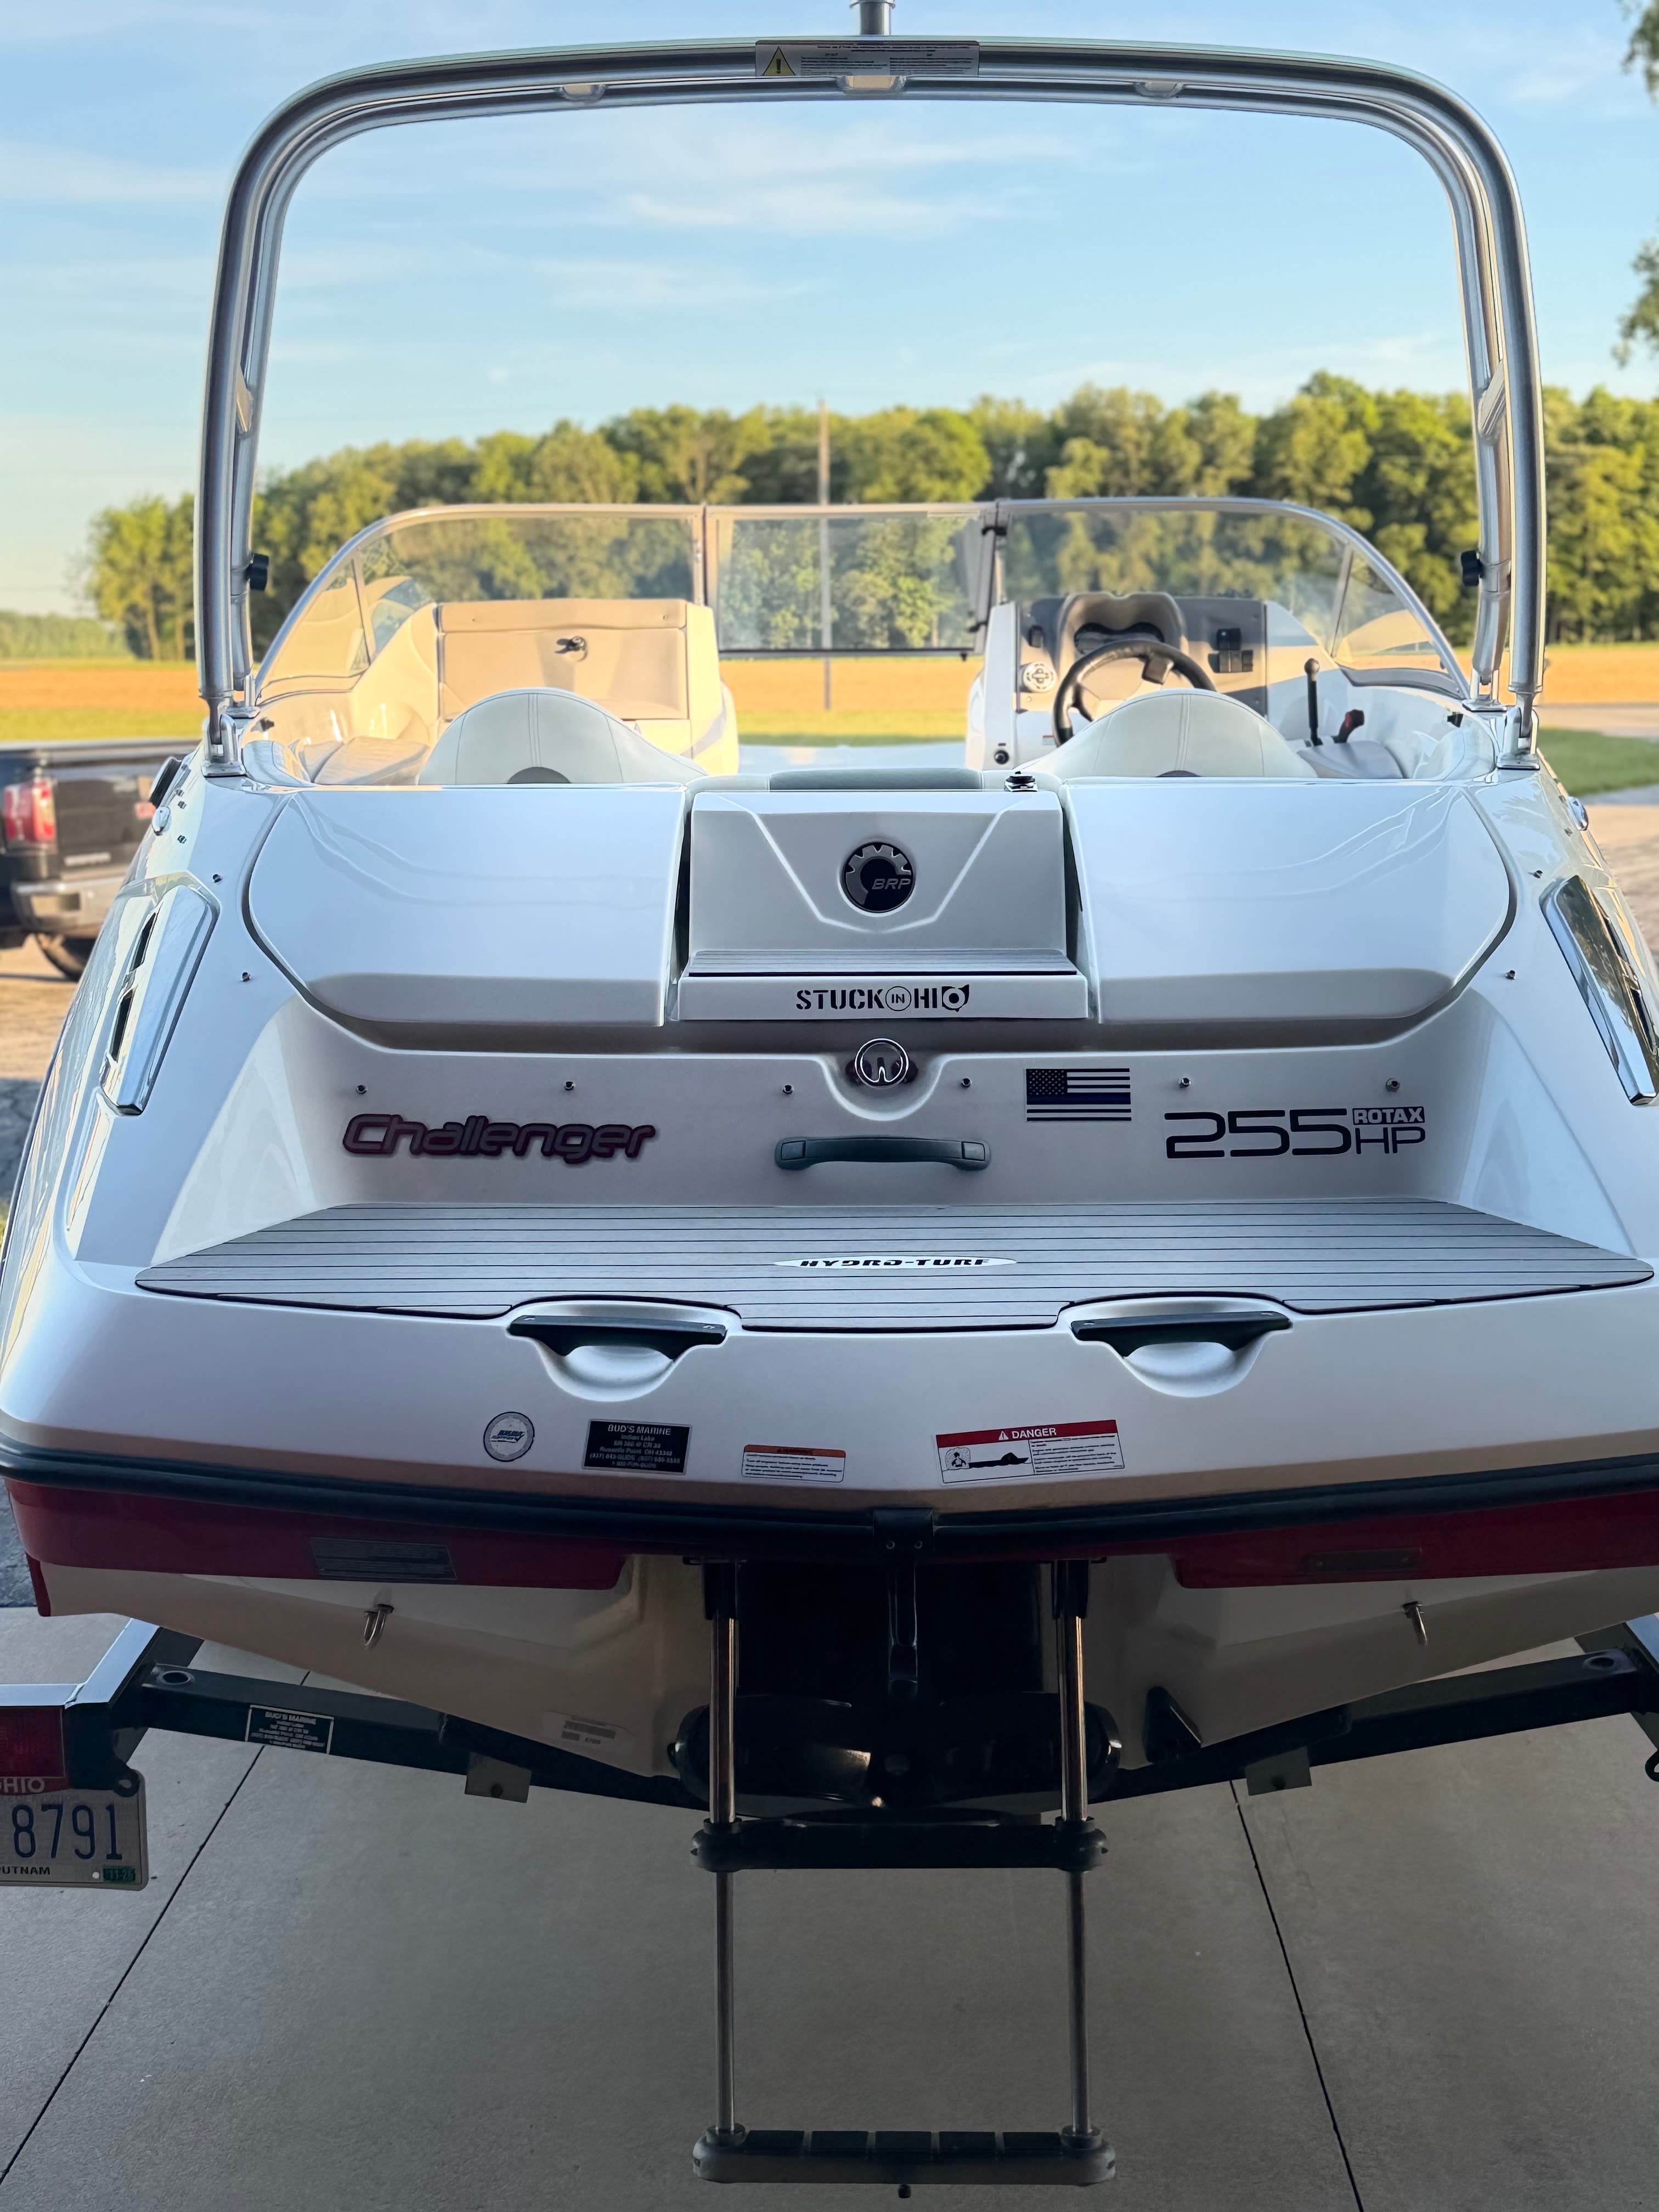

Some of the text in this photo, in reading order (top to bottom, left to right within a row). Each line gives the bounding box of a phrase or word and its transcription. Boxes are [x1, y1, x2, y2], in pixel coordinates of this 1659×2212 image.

[872, 878, 911, 890] BRP
[795, 989, 885, 1010] STUCK
[891, 993, 905, 1004] IN
[1354, 1107, 1424, 1125] ROTAX
[342, 1113, 656, 1164] Challenger
[1164, 1108, 1426, 1159] 255 HP
[608, 1424, 672, 1436] BUD'S MARINE
[1012, 1427, 1057, 1440] DANGER
[0, 1777, 46, 1793] HIO
[12, 1803, 123, 1860] 8791
[0, 1866, 50, 1875] UTNAM
